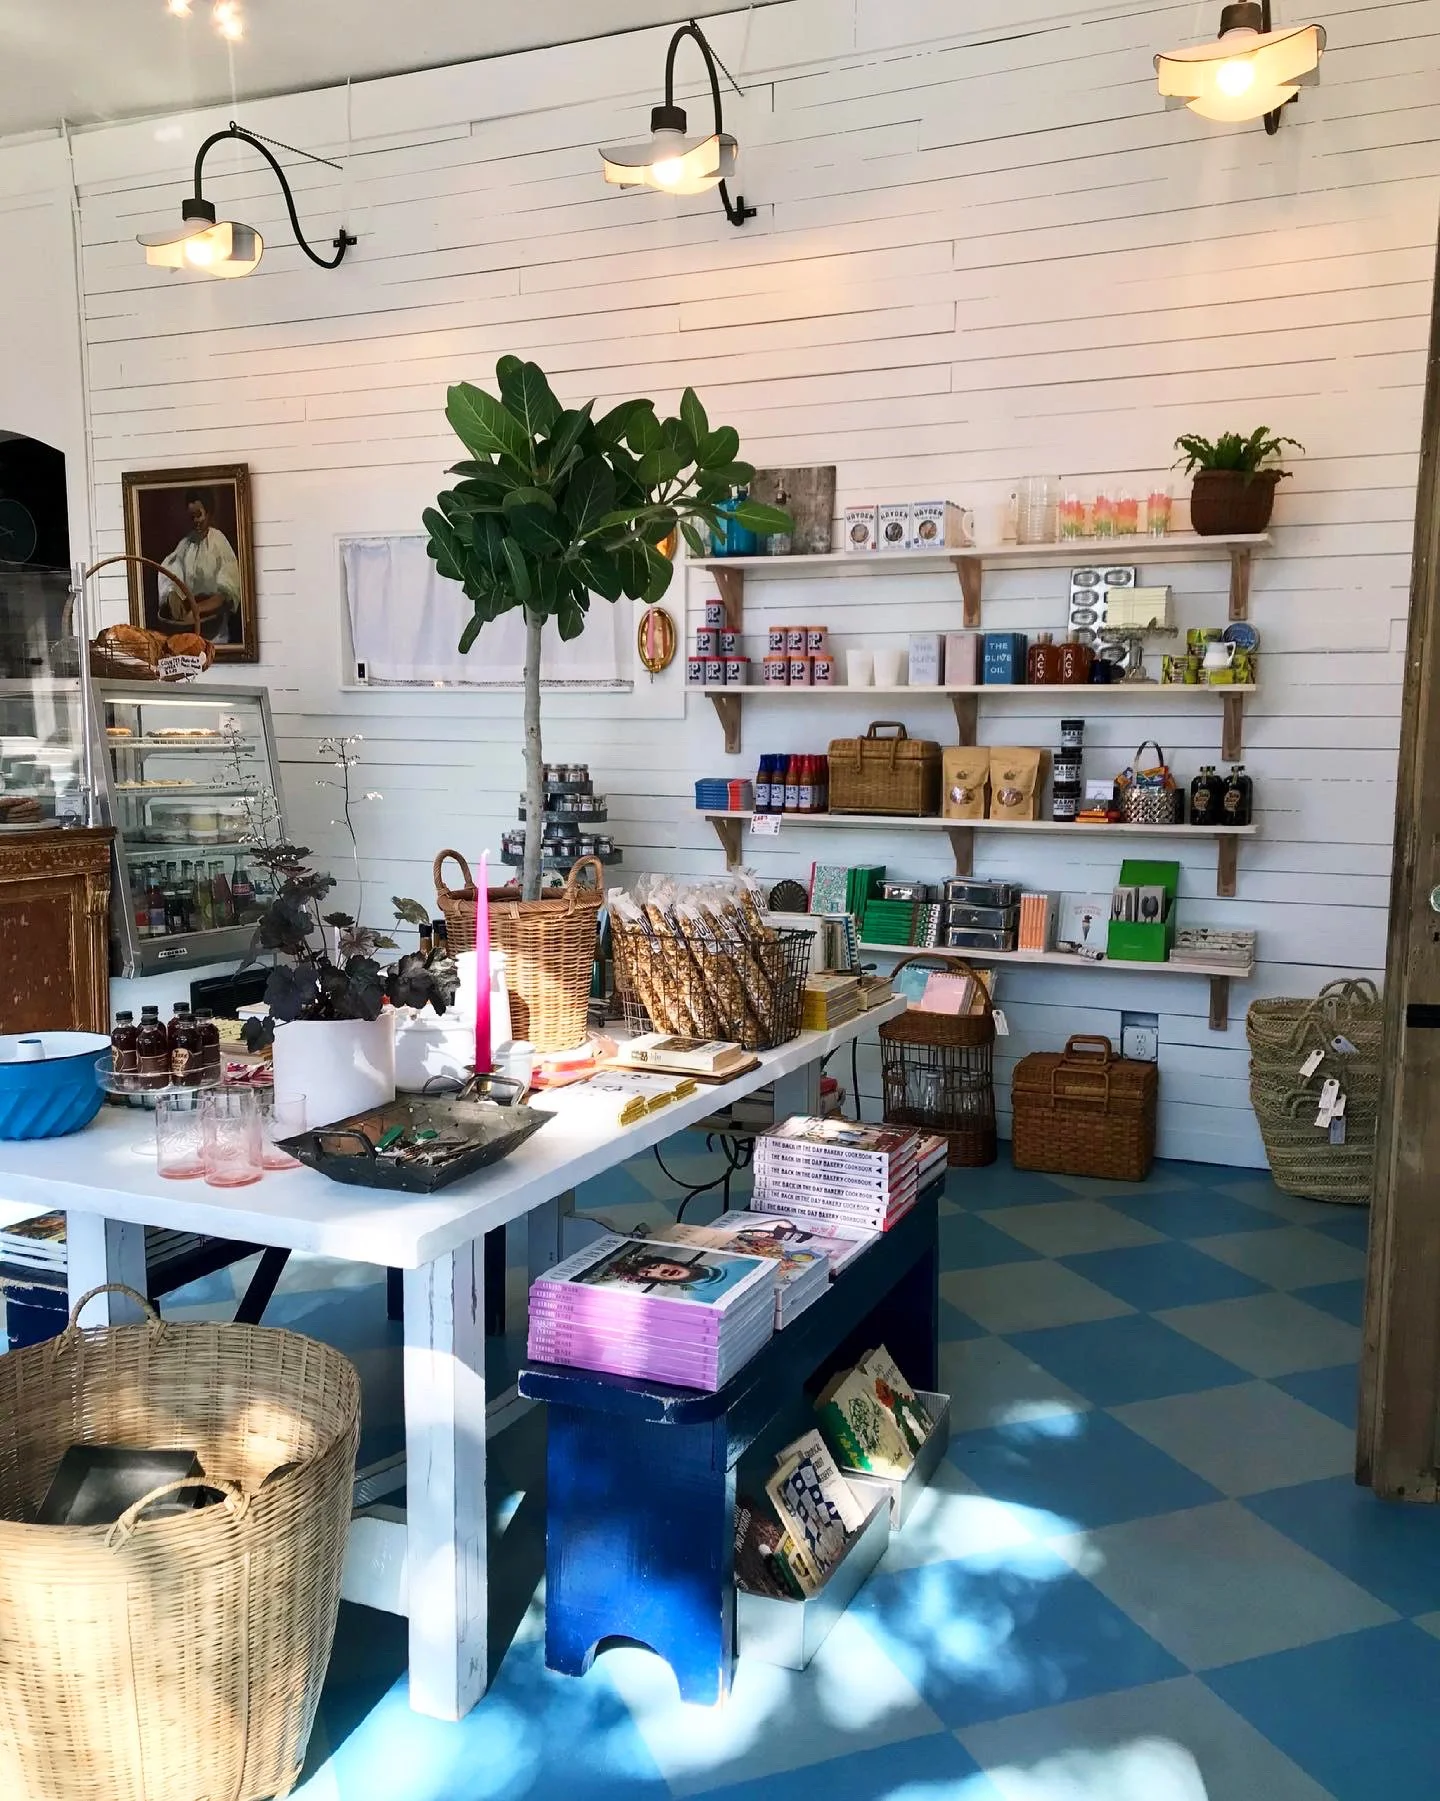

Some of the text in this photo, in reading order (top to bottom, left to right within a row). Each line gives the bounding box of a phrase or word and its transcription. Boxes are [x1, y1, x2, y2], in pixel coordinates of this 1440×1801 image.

[989, 642, 1008, 650] THE
[985, 653, 1012, 662] OLIVE
[990, 666, 1004, 674] OIL
[782, 1141, 795, 1149] BACK
[845, 1152, 872, 1160] COOKBOOK
[845, 1164, 872, 1172] COOKBOOK
[844, 1177, 872, 1186] COOKBOOK
[822, 1199, 841, 1207] BAKERY
[843, 1203, 869, 1211] COOKBOOK
